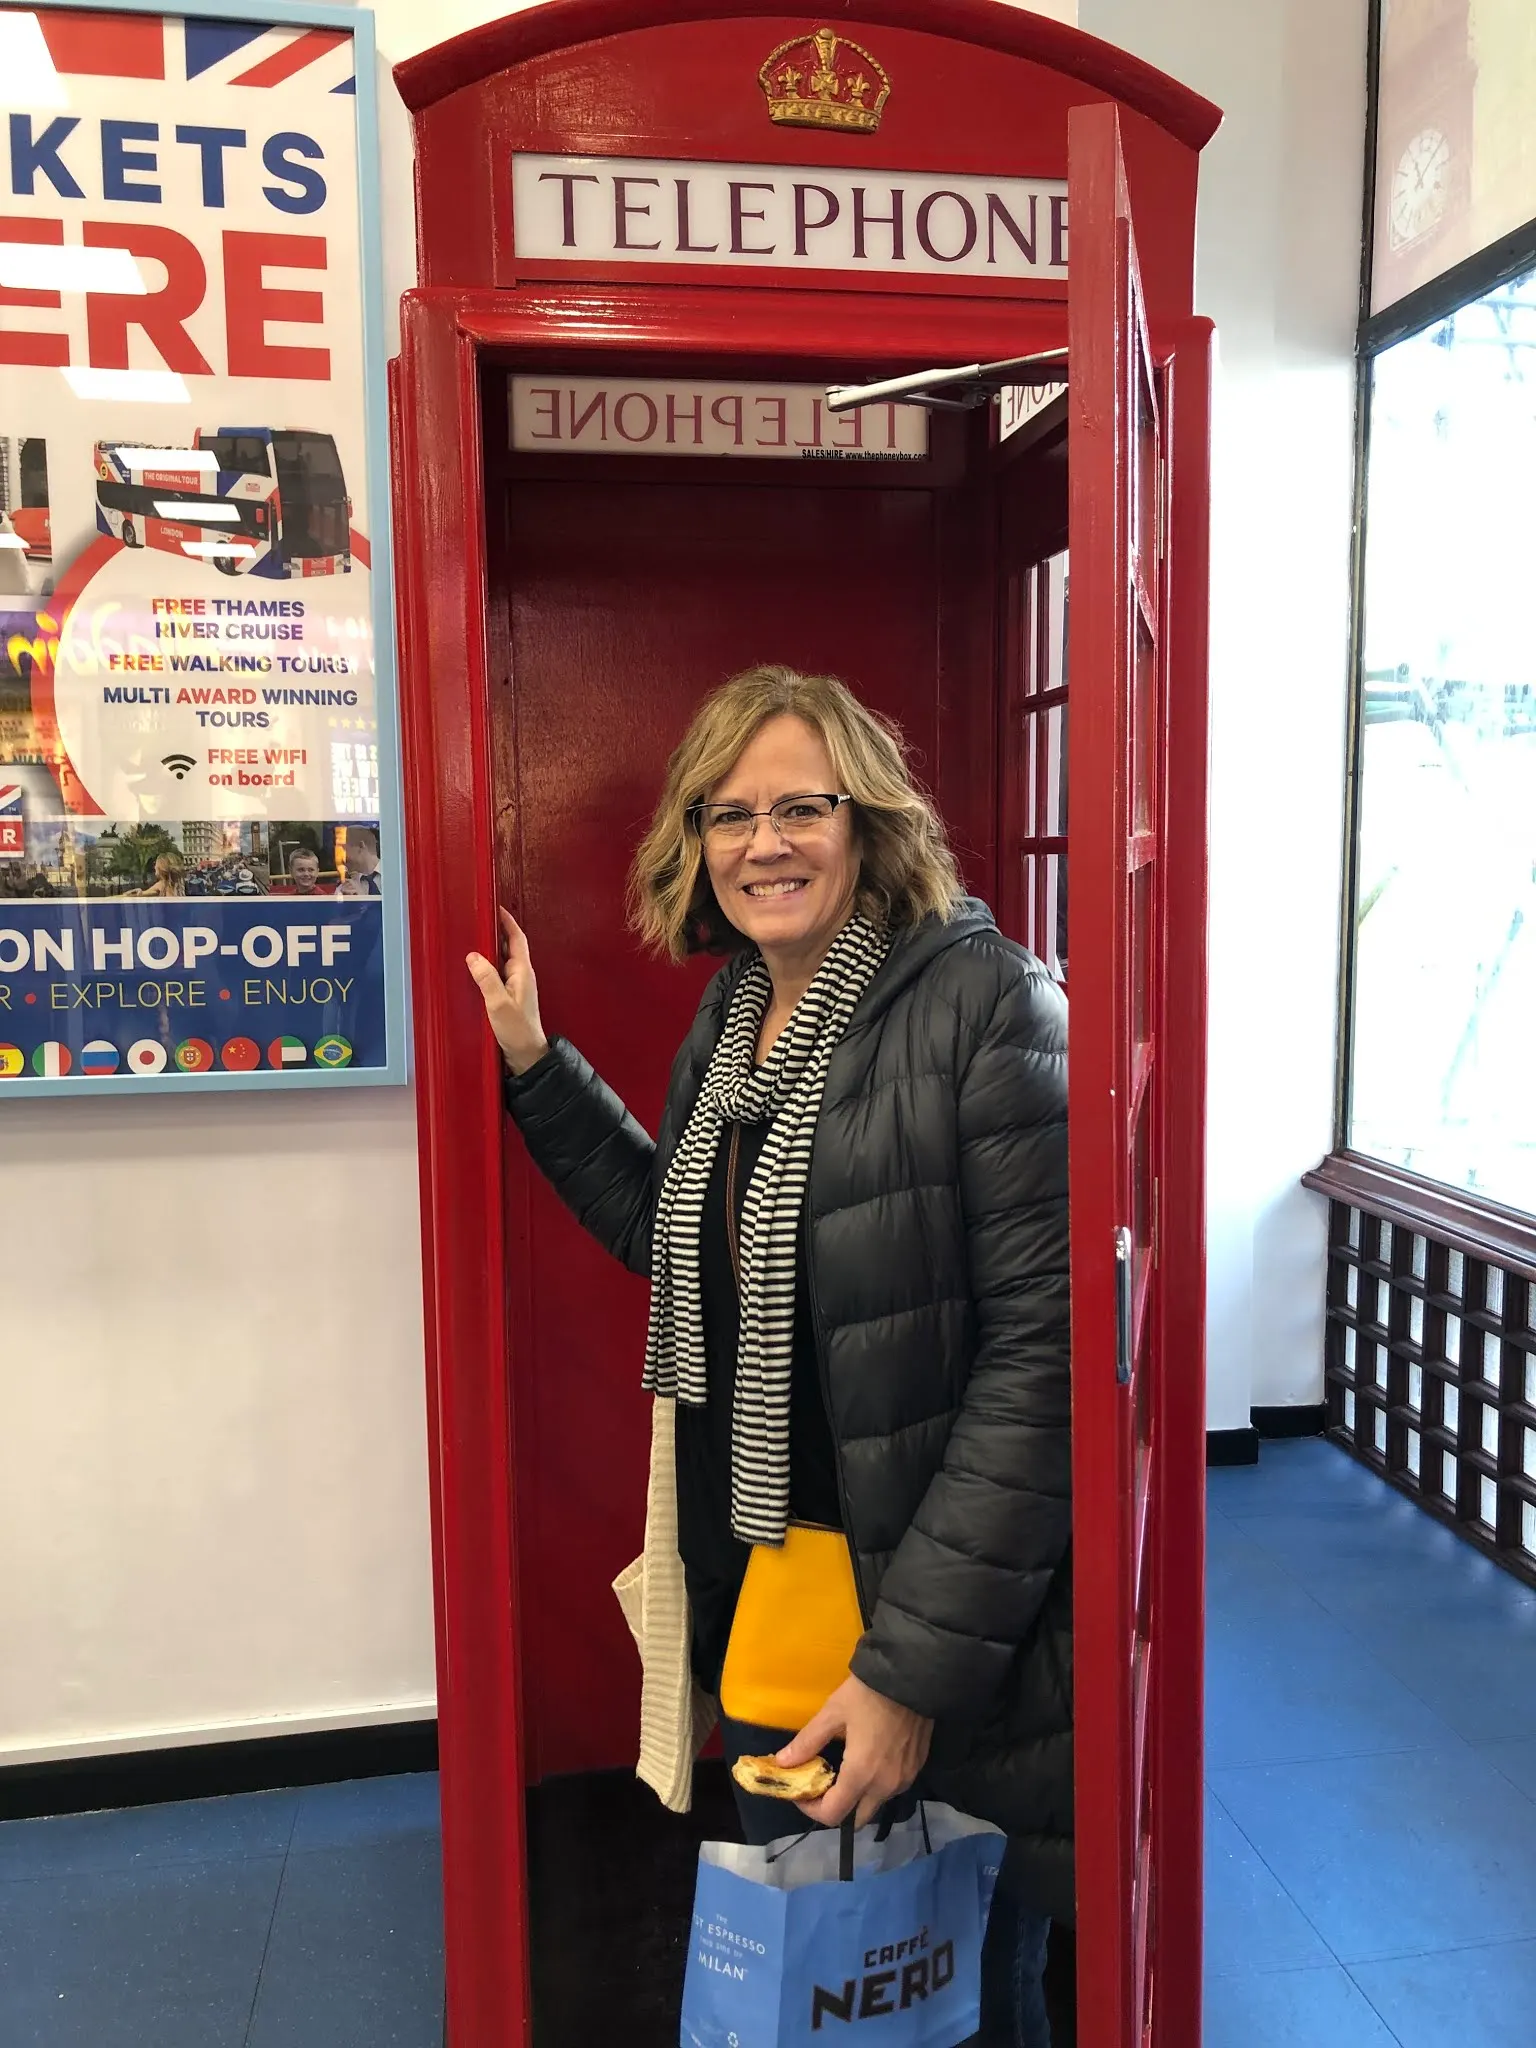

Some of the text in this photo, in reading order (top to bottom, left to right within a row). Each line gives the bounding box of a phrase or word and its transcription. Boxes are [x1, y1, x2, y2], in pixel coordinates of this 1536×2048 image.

[9, 113, 327, 215] KETS
[144, 472, 199, 485] THE ORIGINAL TOUR
[152, 598, 305, 618] FREE THAMES
[155, 622, 303, 641] RIVER CRUISE
[109, 654, 164, 671] FREE
[170, 655, 272, 673] WALKING
[103, 687, 358, 706] MULTI AWARD WINNING
[196, 710, 270, 728] TOURS
[208, 748, 307, 766] FREE WIFI
[208, 769, 295, 787] on board
[0, 924, 352, 973] ON HOP-OFF
[50, 980, 207, 1010] EXPLORE
[244, 977, 355, 1006] ENJOY
[708, 1923, 766, 1955] ESPRESSO
[698, 1950, 745, 1982] MILAN
[811, 1938, 956, 2032] NERO
